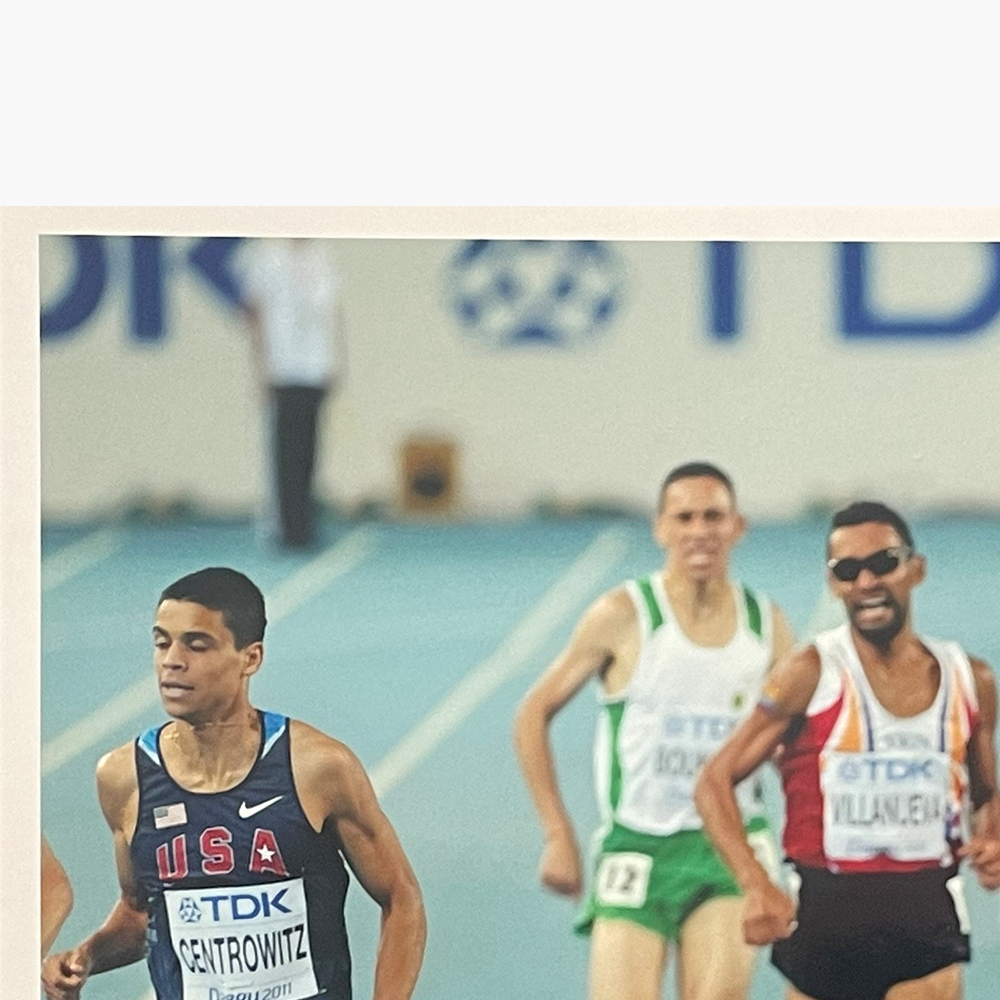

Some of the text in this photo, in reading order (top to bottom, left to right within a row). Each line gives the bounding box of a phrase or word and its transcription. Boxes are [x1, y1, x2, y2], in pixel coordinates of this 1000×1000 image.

[863, 759, 934, 781] TDK
[156, 826, 290, 880] USA
[200, 888, 292, 922] TDK
[179, 924, 307, 975] CENTROWITZ
